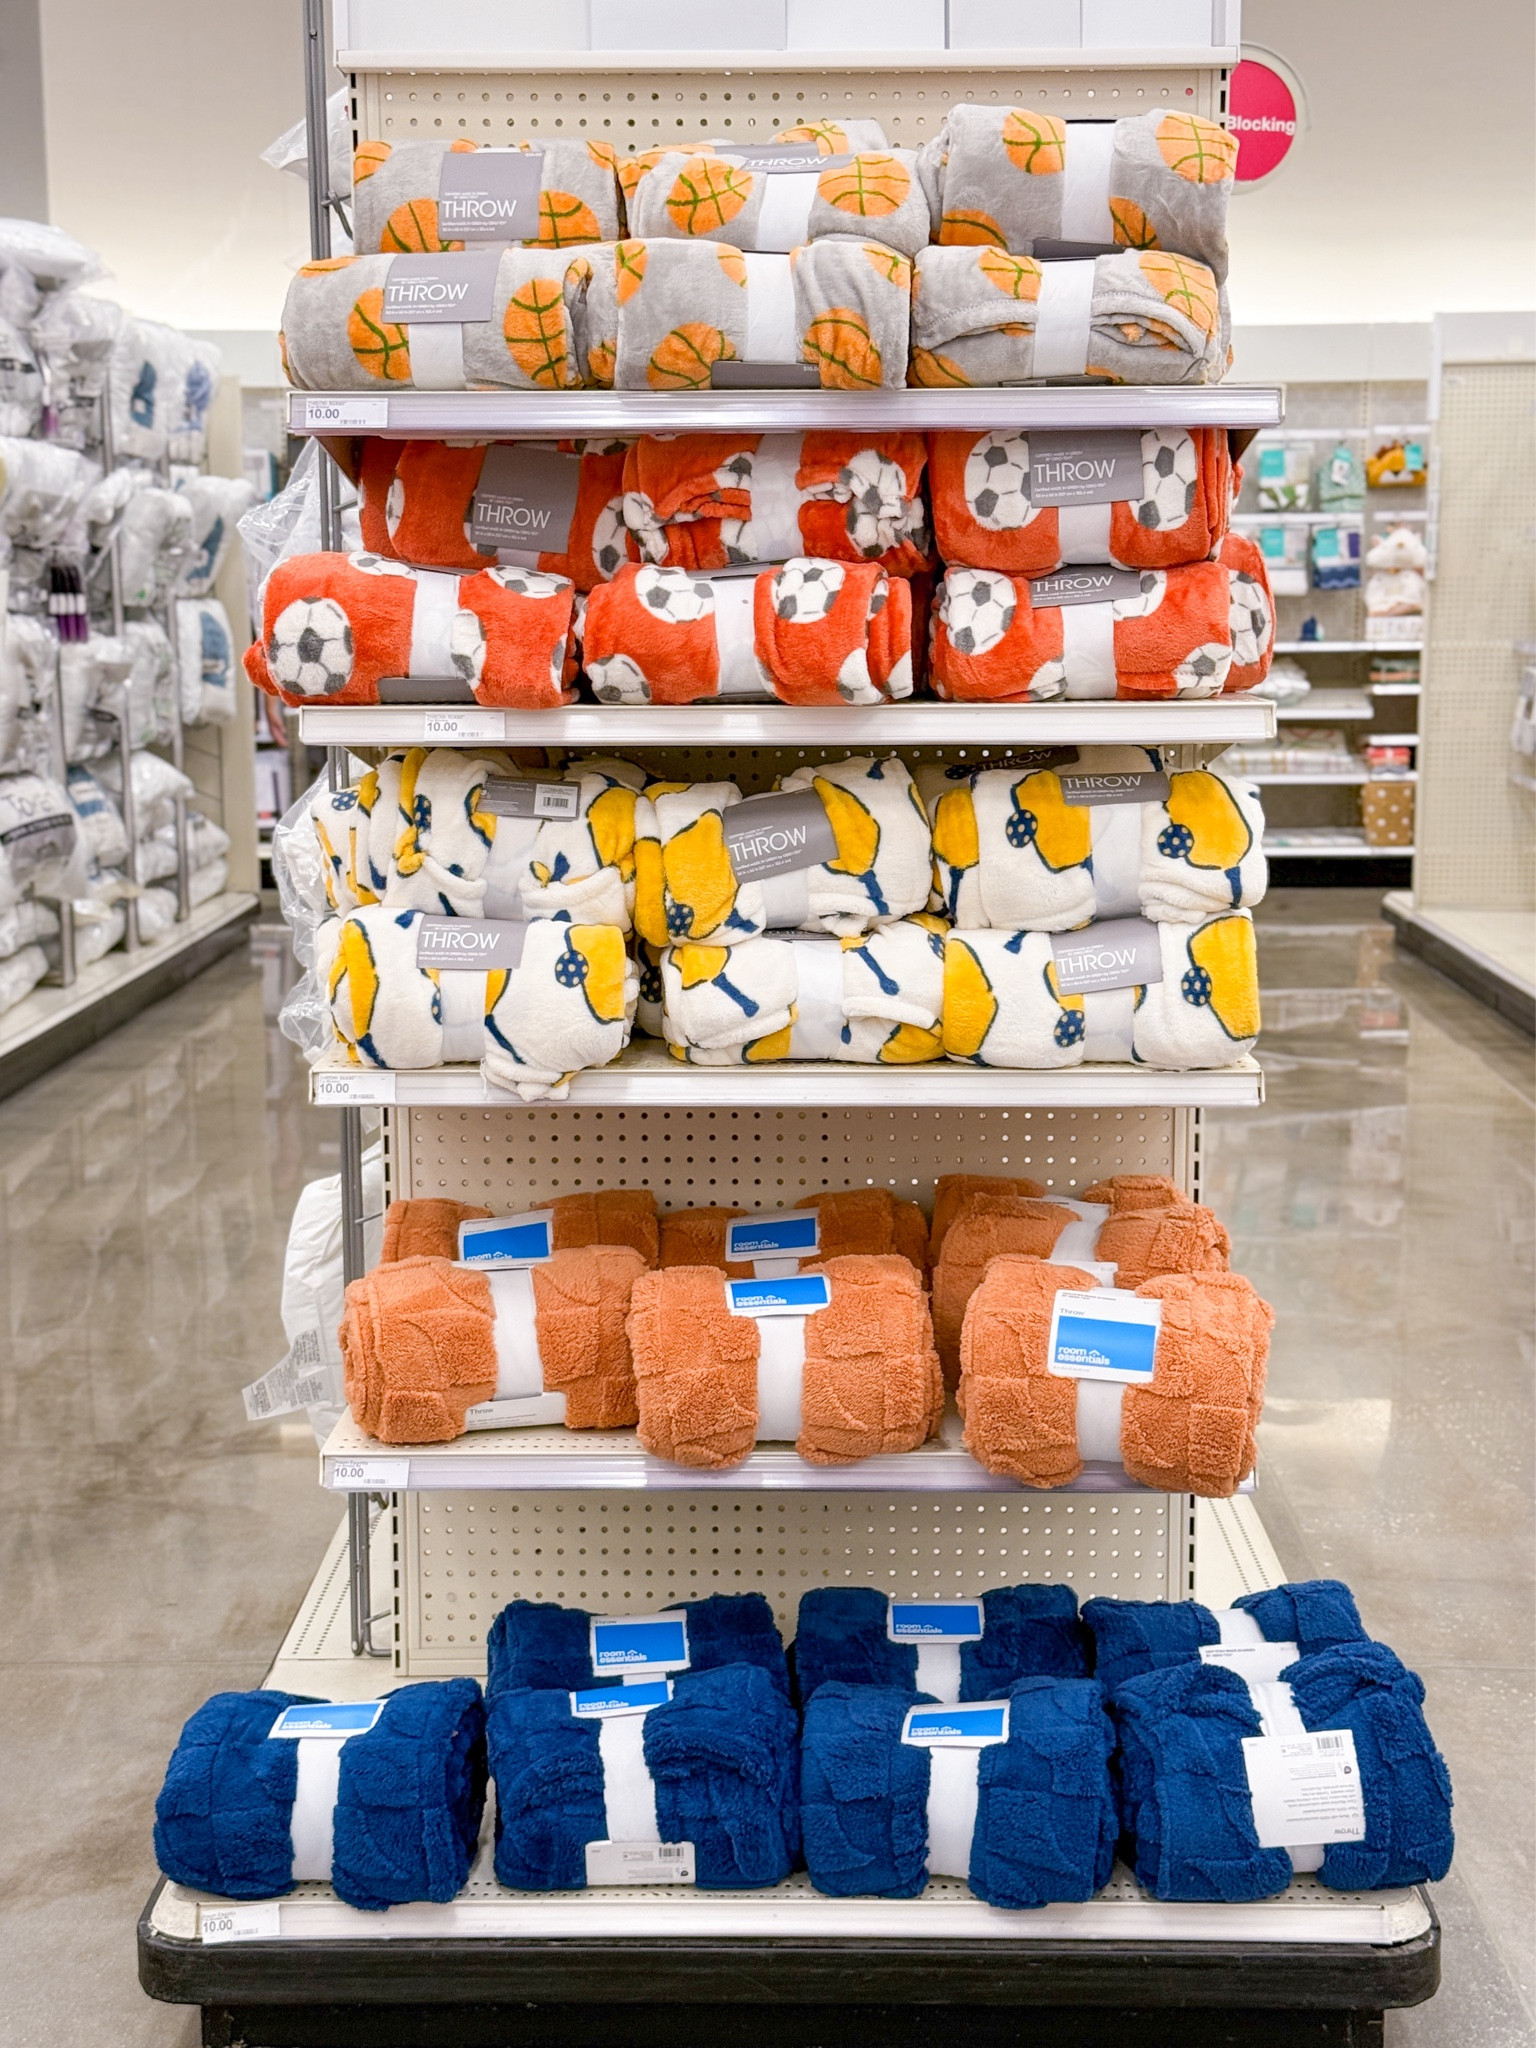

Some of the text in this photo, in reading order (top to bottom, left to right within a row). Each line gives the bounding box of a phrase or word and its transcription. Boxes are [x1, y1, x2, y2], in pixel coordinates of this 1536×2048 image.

[1227, 115, 1296, 136] Blocking
[748, 157, 828, 167] THROW
[442, 200, 517, 218] THROW
[388, 283, 469, 302] THROW
[308, 408, 340, 419] 10.00
[1033, 459, 1116, 483] THROW
[477, 503, 551, 529] THROW
[1032, 575, 1114, 592] THROW
[427, 722, 458, 731] 10.00
[980, 750, 1052, 771] THROW
[1063, 775, 1141, 789] THROW
[729, 825, 806, 862] THROW
[422, 931, 500, 949] THROW
[1056, 948, 1136, 975] THROW
[319, 1083, 350, 1094] 10.00
[733, 1241, 780, 1252] essentials
[735, 1297, 788, 1307] essentials
[1060, 1308, 1085, 1316] Throw
[1058, 1346, 1087, 1355] room
[1057, 1354, 1111, 1366] essentials
[334, 1468, 364, 1478] 10.00
[599, 1653, 648, 1664] essentials
[1334, 1827, 1360, 1835] Throw
[203, 1920, 233, 1932] 10.00
